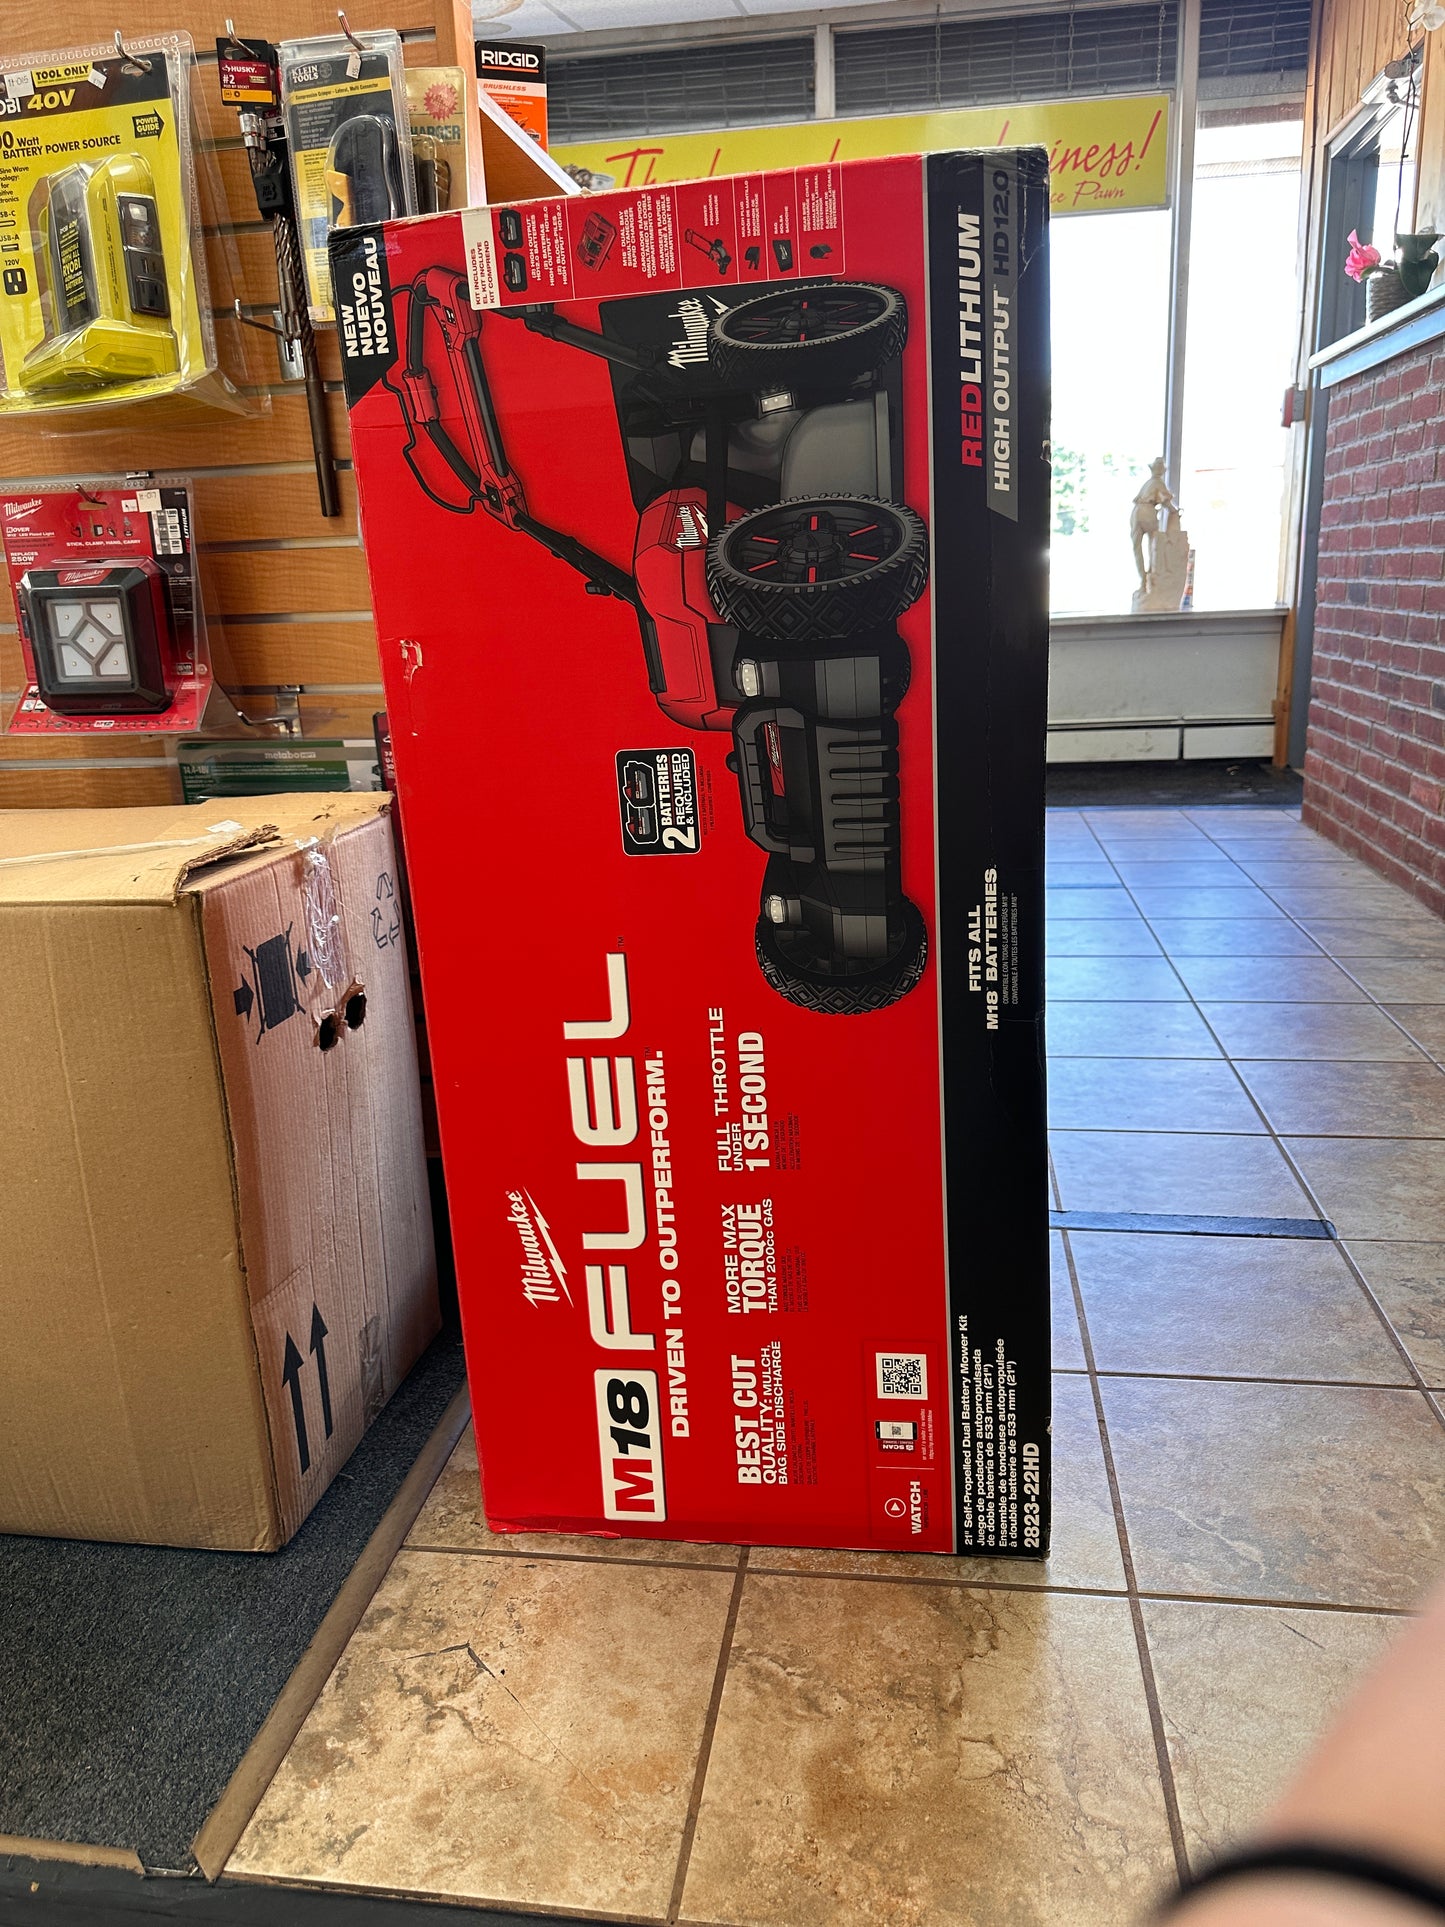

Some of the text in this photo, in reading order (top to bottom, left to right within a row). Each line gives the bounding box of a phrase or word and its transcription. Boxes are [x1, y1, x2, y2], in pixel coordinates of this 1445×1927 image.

[35, 69, 61, 81] TOOL
[64, 65, 89, 76] ONLY
[222, 74, 236, 85] #2
[291, 64, 318, 76] KLEIN
[292, 72, 319, 83] TOOLS
[481, 50, 539, 68] RIDGID
[0, 89, 76, 116] OBI 40V
[483, 83, 527, 91] BRUSHLESS
[136, 117, 158, 125] POWER
[136, 123, 160, 132] GUIDE
[411, 125, 461, 140] HARGER
[3, 135, 121, 160] BATTERY POWER SOURCE
[1049, 109, 1162, 178] iness!
[1050, 180, 1126, 207] ce Pawn
[531, 215, 539, 254] BATTERIES
[552, 216, 561, 264] BLOCS-PILES
[624, 210, 632, 267] SIMULTANEOUS
[648, 212, 657, 277] COMPARTIMENTO
[667, 214, 675, 272] COMPARTIMENT
[63, 257, 81, 277] RYOBI
[471, 248, 479, 290] INCLUDES
[477, 242, 486, 280] INCLUYE
[484, 240, 494, 289] COMPREND
[352, 272, 374, 356] NUEVO
[363, 237, 390, 354] NOUVEAU
[341, 304, 359, 357] NEW
[667, 298, 711, 370] Milwaukee
[992, 170, 1011, 492] HIGH OUTPUT HD12.0
[4, 499, 42, 516] Milwaukee
[675, 505, 702, 549] Milwaukee
[64, 570, 104, 581] Milwaukee
[264, 751, 300, 760] metabo
[656, 754, 696, 849] 2 BATTERIES
[671, 753, 686, 825] REQUIRED
[681, 753, 694, 825] & INCLUDED
[968, 904, 982, 992] FITS ALL
[986, 990, 999, 1030] M18
[708, 1007, 732, 1171] FULL THROTTLE
[738, 1031, 770, 1172] 1 SECOND
[731, 1122, 744, 1171] UNDER
[563, 952, 655, 1513] M18 FUEL
[762, 1198, 773, 1227] GAS
[507, 1190, 560, 1309] Milwaukee
[645, 1050, 690, 1438] DRIVEN TO OUTPERFORM.
[721, 1204, 741, 1313] MORE MAX
[737, 1204, 767, 1313] TORQUE
[766, 1277, 778, 1314] THAN
[983, 1363, 994, 1389] (21")
[1006, 1361, 1017, 1386] (21")
[731, 1354, 762, 1484] BEST CUT
[759, 1345, 777, 1484] QUALITY: MULCH,
[771, 1341, 788, 1485] BAG, SIDE DISCHARGE
[985, 1392, 993, 1414] mm
[1008, 1389, 1016, 1411] mm
[959, 1314, 973, 1545] 21" Self-Propelled Dual Battery Mower Kit
[985, 1416, 993, 1439] 533
[995, 1338, 1008, 1547] Ensemble de tondeuse autopropulsée
[1007, 1413, 1016, 1437] 533
[1008, 1439, 1016, 1454] de
[972, 1349, 987, 1546] Juego de podadora autopropulsada
[985, 1442, 994, 1457] de
[1008, 1456, 1017, 1500] batterie
[1023, 1443, 1040, 1548] 2823-22HD
[910, 1481, 922, 1534] WATCH
[986, 1501, 995, 1532] doble
[1008, 1502, 1018, 1539] double
[987, 1534, 995, 1547] de
